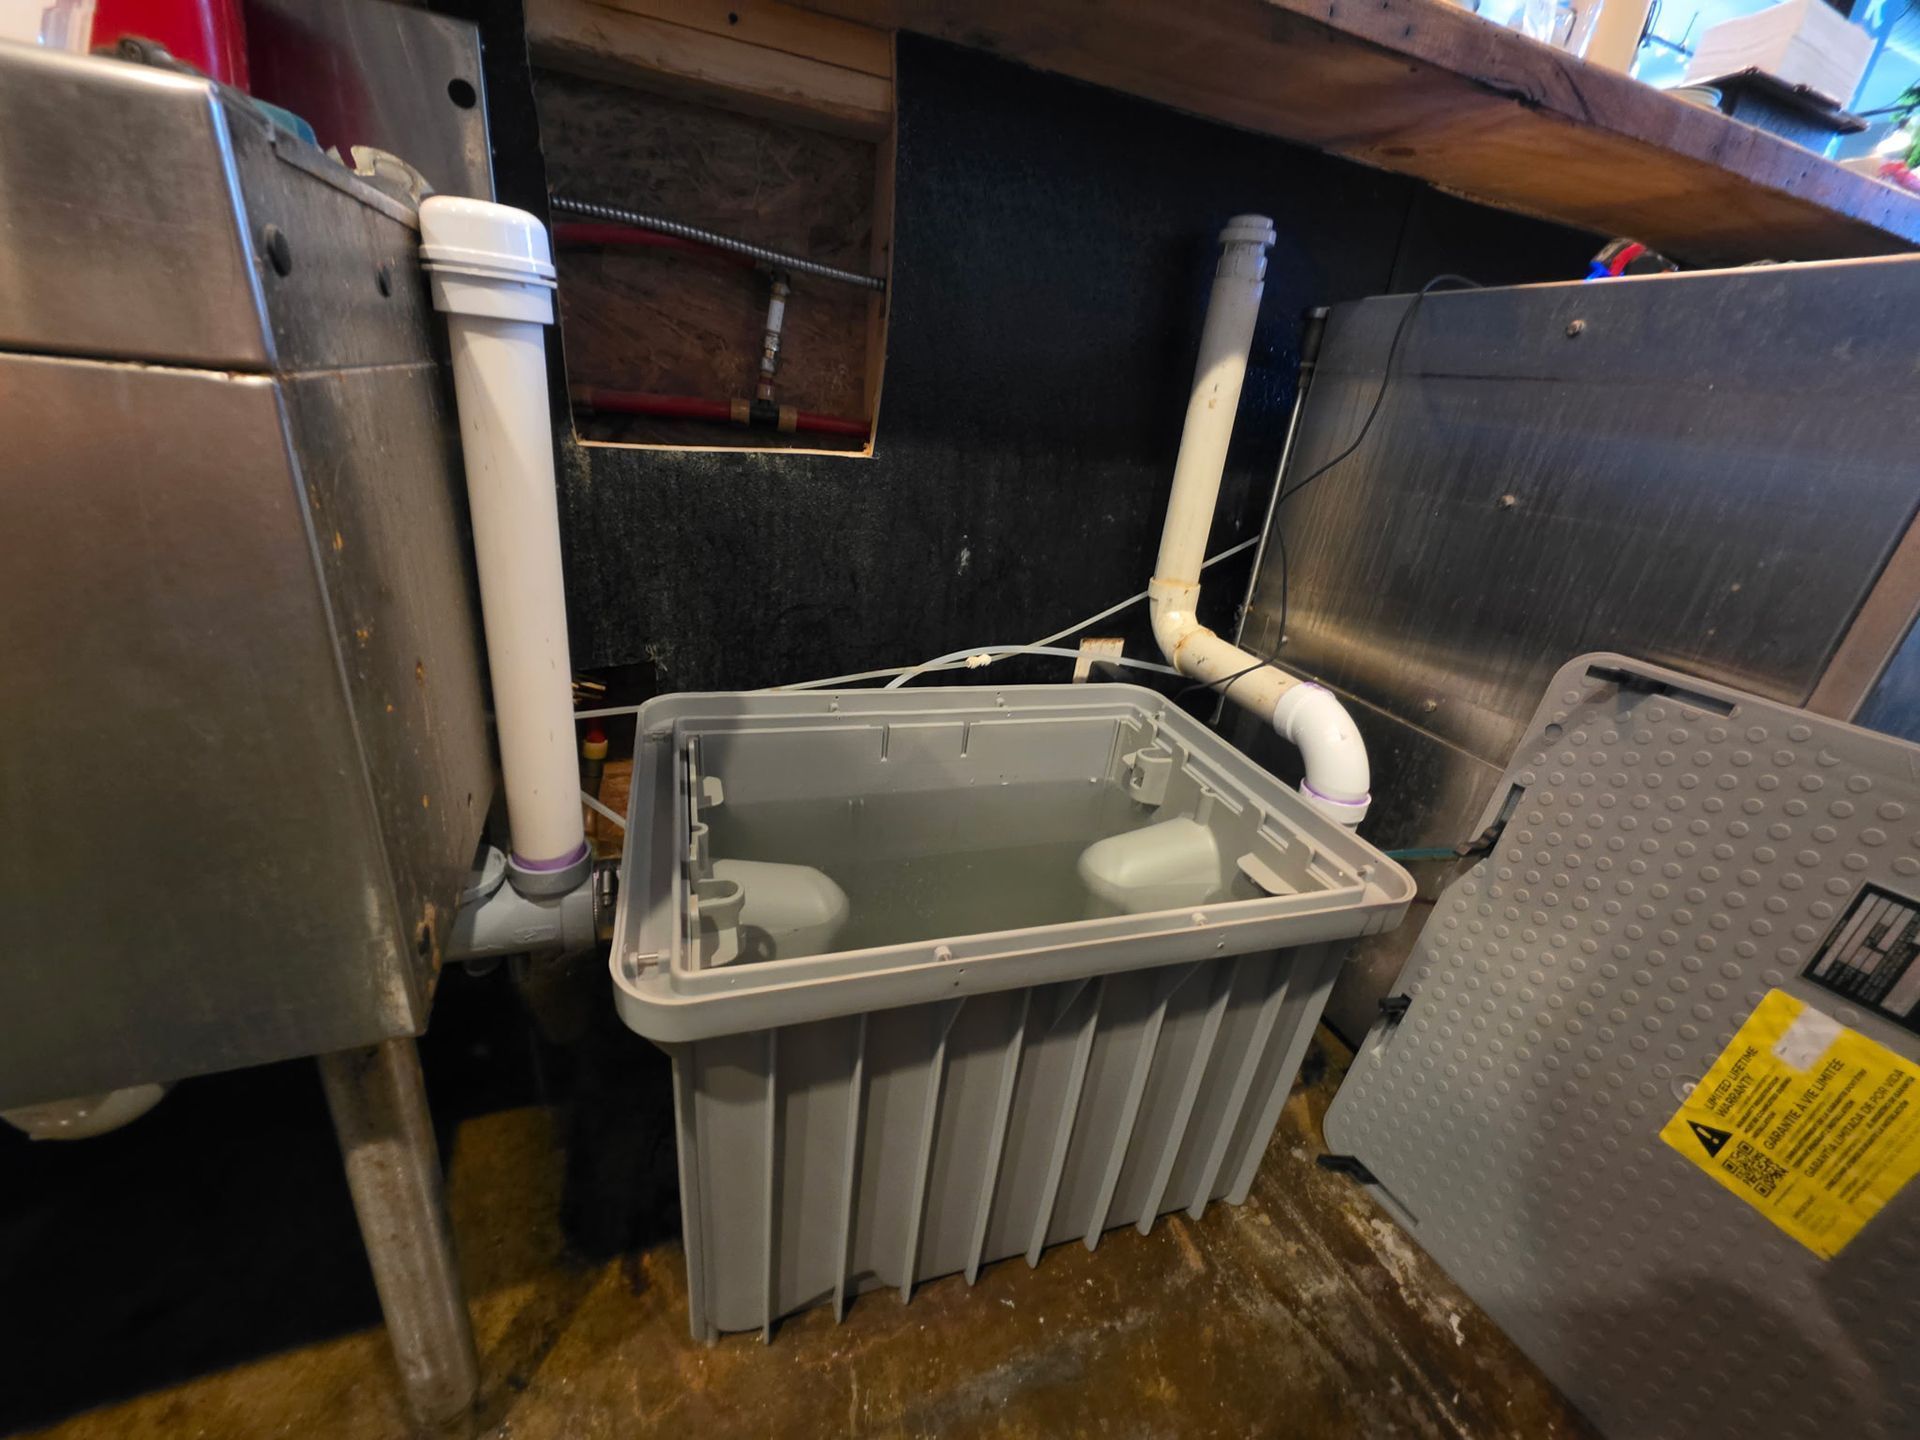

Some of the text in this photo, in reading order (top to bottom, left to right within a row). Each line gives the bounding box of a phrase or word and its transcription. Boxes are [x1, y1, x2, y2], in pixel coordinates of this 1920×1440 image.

[1703, 1077, 1732, 1111] LIMITED
[1726, 1044, 1758, 1081] LIFETIME
[1715, 1072, 1755, 1118] WARRANTY
[1761, 1108, 1802, 1152] GARANTIE
[1799, 1087, 1819, 1106] VIE
